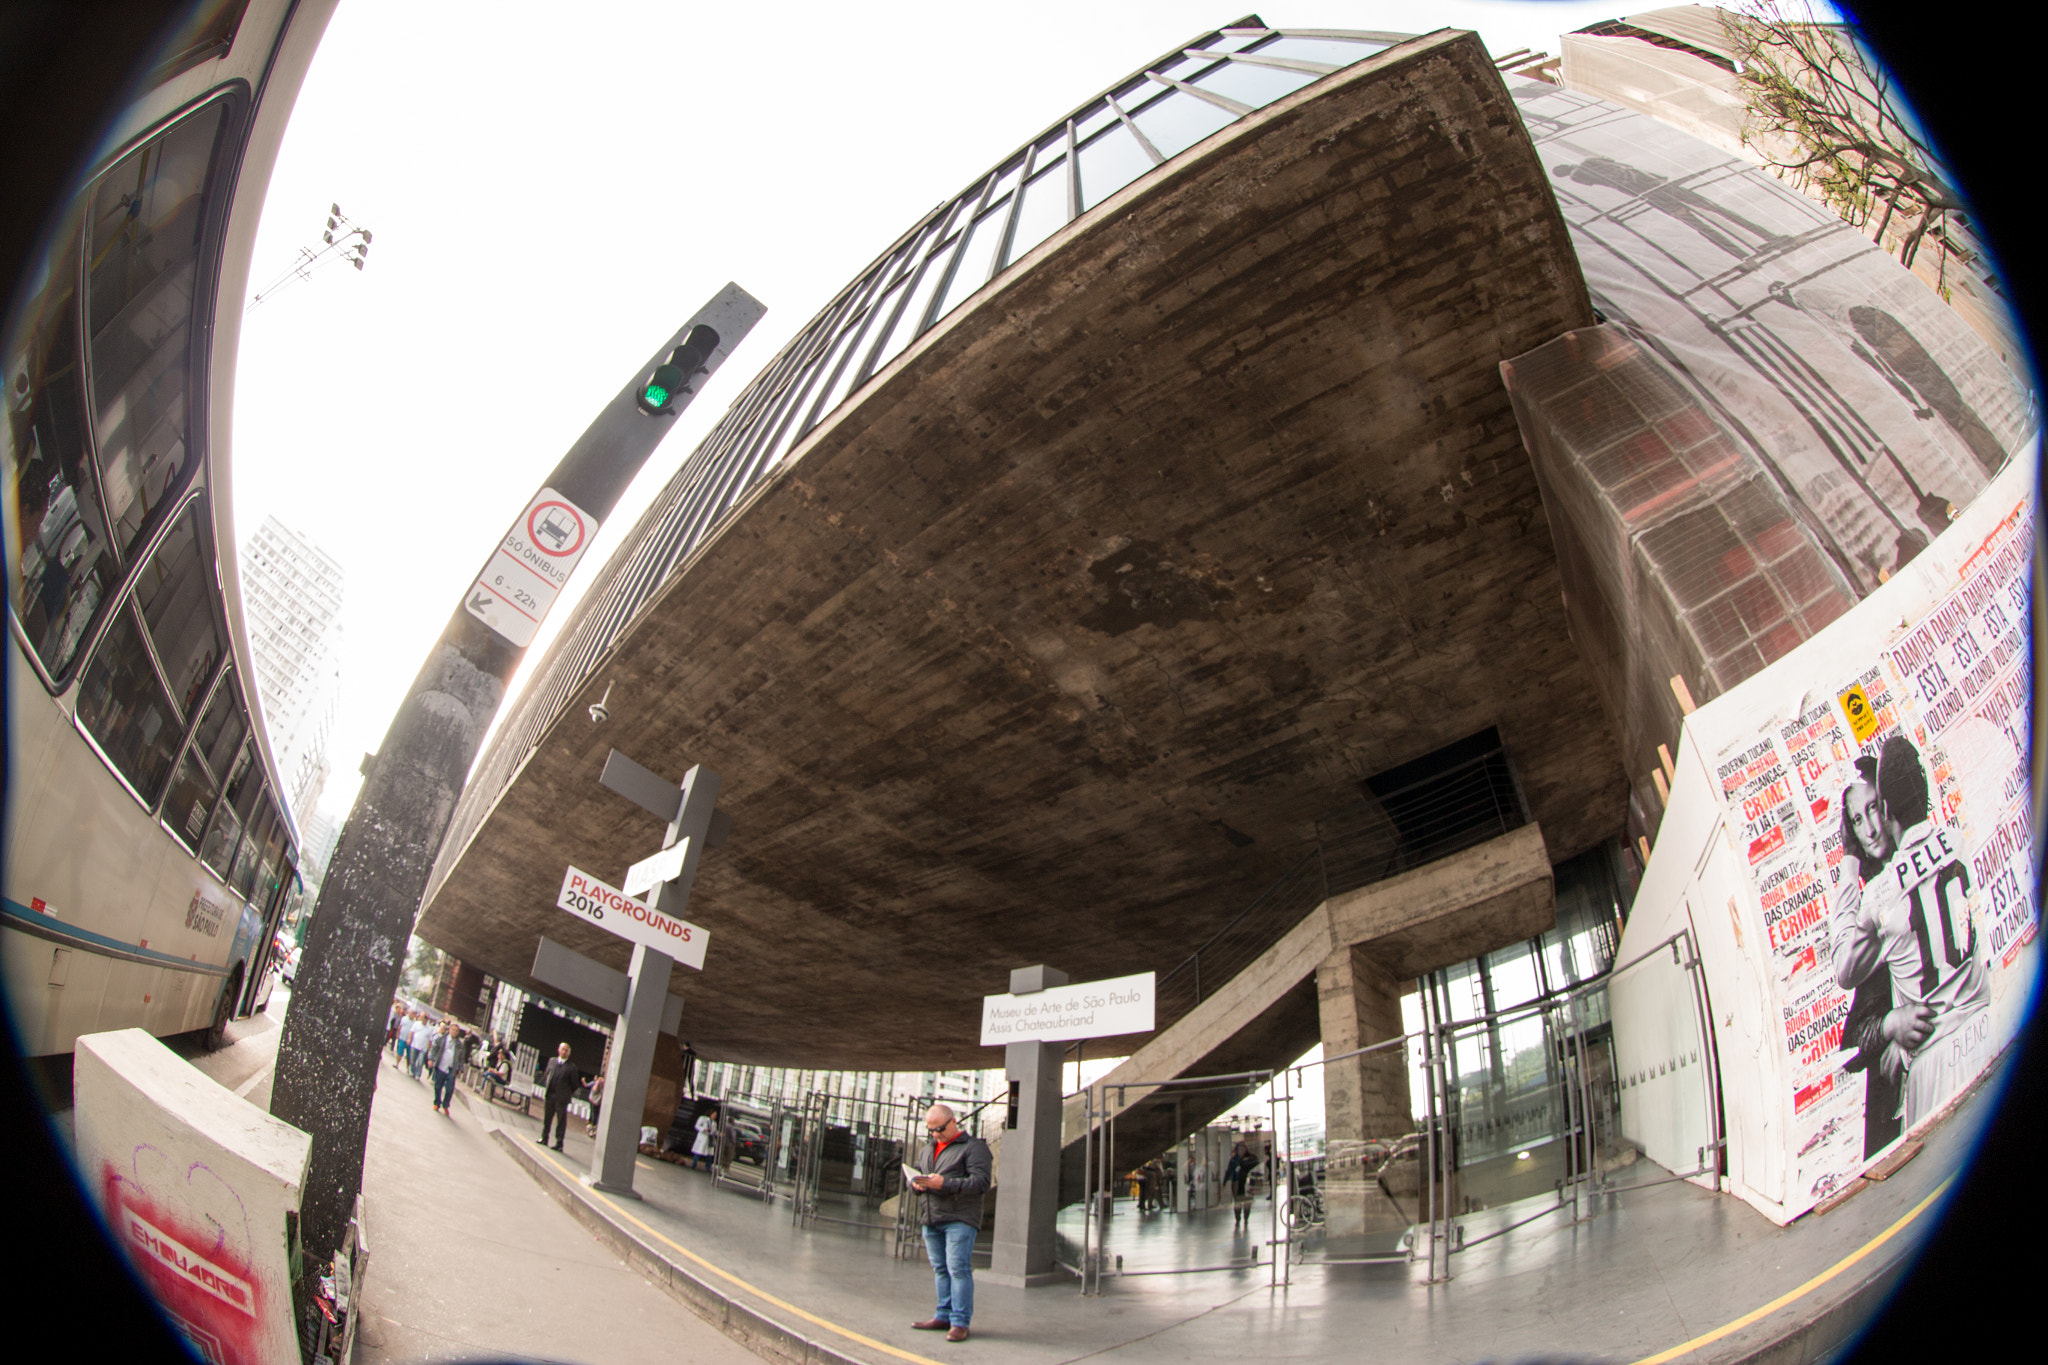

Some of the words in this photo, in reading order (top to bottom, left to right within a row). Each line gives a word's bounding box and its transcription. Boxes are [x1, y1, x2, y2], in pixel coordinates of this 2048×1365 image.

[506, 535, 523, 552] SÓ
[494, 575, 505, 586] 6
[514, 588, 537, 610] 22h
[1893, 624, 1938, 678] DAMIEN
[1930, 595, 1971, 645] DAMIEN
[1962, 569, 1998, 617] DAMIEN
[1859, 665, 1881, 686] TUCANO
[1923, 687, 1964, 735] VOLTANDO
[1960, 655, 1995, 699] VOLTANDO
[1991, 626, 2022, 668] VOLTANDO
[1780, 716, 1810, 741] GOVERNO
[1807, 700, 1832, 724] TUCANO
[1785, 731, 1809, 755] ROUBA
[1807, 712, 1838, 741] MERENDA
[1717, 752, 1749, 780] GOVERNO
[1747, 737, 1774, 761] TUCANO
[1721, 770, 1747, 792] ROUBA
[1745, 750, 1780, 779] MERENDA
[1791, 748, 1809, 767] DAS
[1896, 828, 1954, 889] PELÉ
[1974, 823, 2014, 890] DAMIEN
[565, 890, 604, 920] 2016
[570, 874, 692, 943] PLAYGROUNDS
[1760, 885, 1786, 912] ROUBA
[1764, 906, 1784, 927] DAS
[1907, 859, 1977, 999] 10
[1989, 896, 2029, 955] VOLTANDO
[988, 1021, 1012, 1034] Assis
[1015, 1012, 1094, 1032] Chateaubriand
[989, 1008, 1021, 1020] Museu
[1024, 1003, 1038, 1015] de
[1040, 1002, 1062, 1014] Arte
[1065, 1000, 1080, 1012] de
[1083, 995, 1105, 1009] São
[1109, 988, 1141, 1006] Paulo
[1785, 1008, 1811, 1037] ROUBA
[1788, 1030, 1807, 1052] DAS
